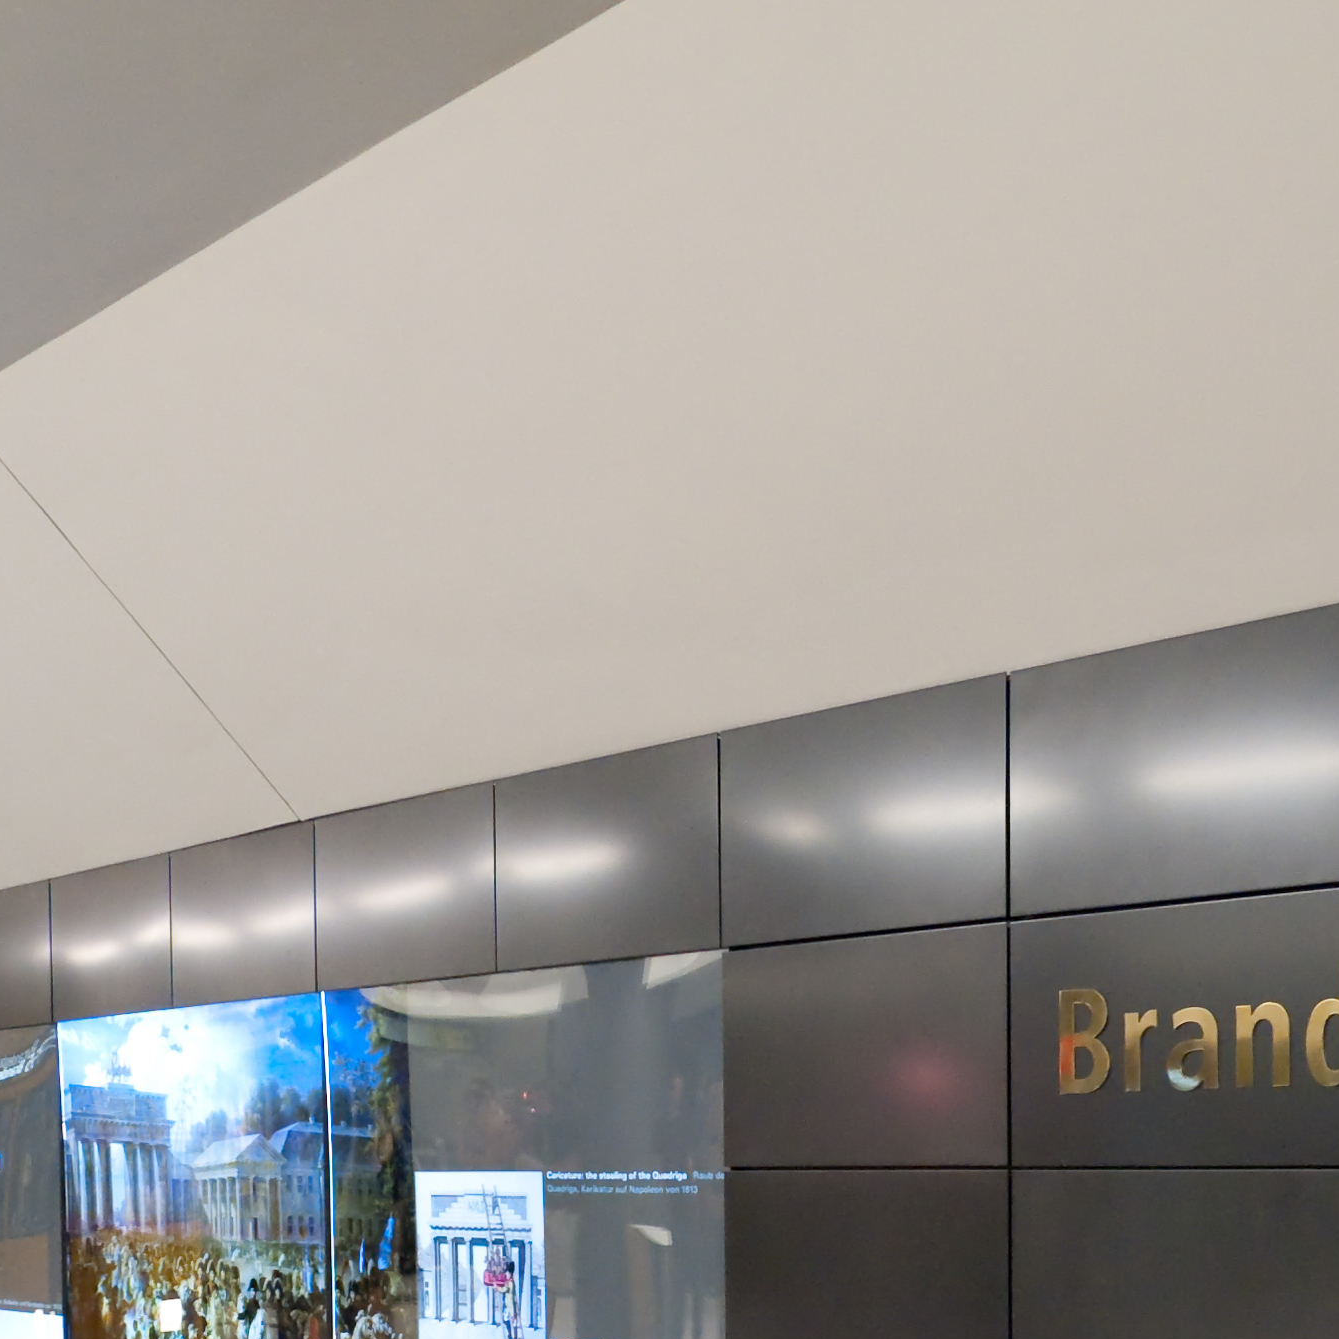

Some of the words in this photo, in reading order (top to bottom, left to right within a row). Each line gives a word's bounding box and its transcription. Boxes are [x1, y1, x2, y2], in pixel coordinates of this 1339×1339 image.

[585, 1170, 598, 1180] the
[628, 1171, 637, 1180] of
[638, 1171, 651, 1180] the
[652, 1170, 688, 1182] Quadriga
